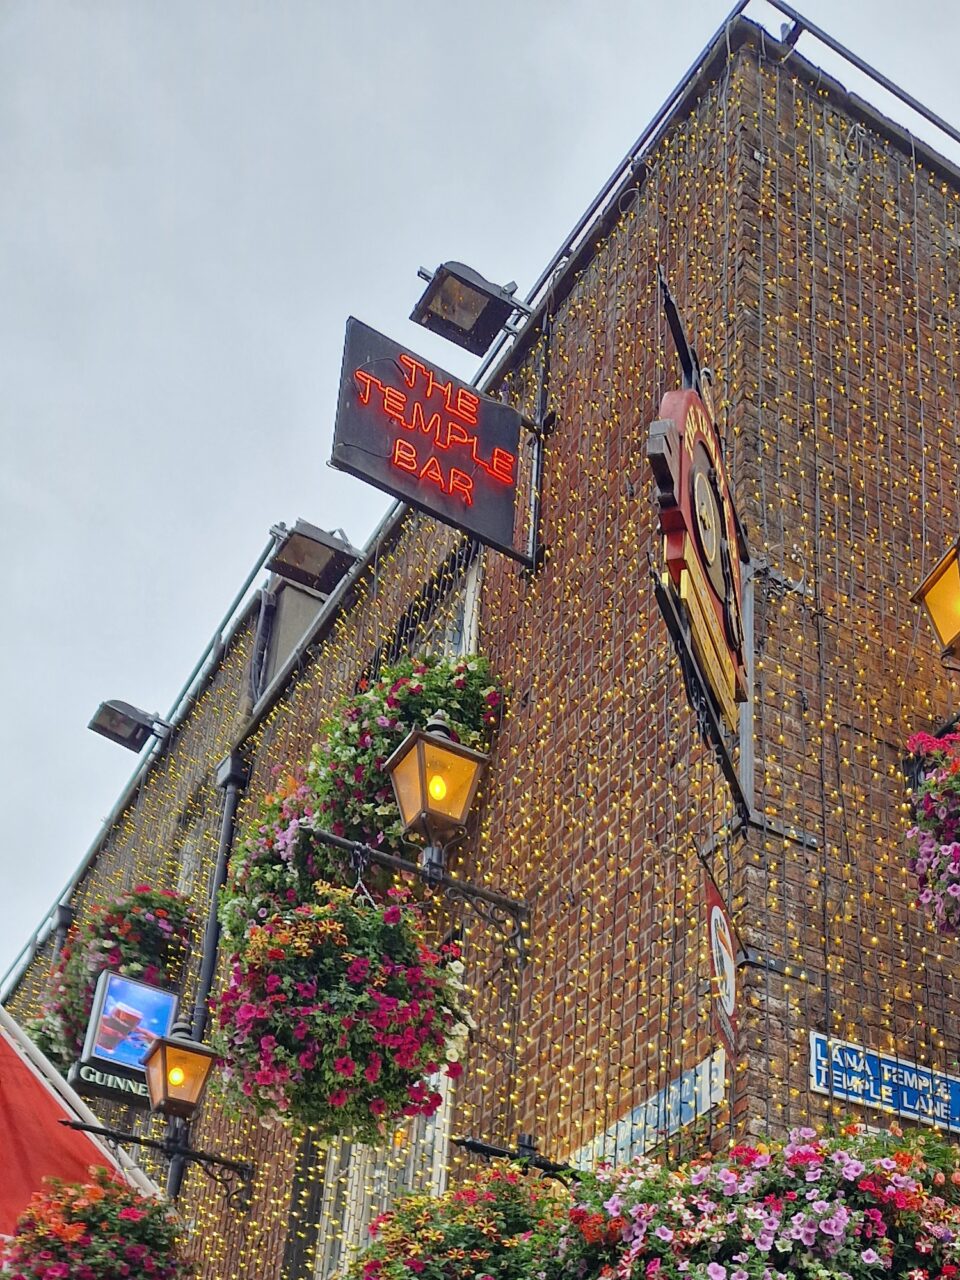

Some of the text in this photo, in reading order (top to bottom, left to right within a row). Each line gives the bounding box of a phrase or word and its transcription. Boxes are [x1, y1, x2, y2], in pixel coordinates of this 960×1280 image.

[400, 354, 480, 424] THE
[355, 370, 515, 484] TEMPLE
[393, 438, 473, 505] BAR
[80, 1065, 150, 1097] GUINNE
[815, 1043, 871, 1077] LANA
[880, 1063, 951, 1099] TEMPLE
[815, 1065, 893, 1105] TEMPLE
[903, 1091, 951, 1120] LANE
